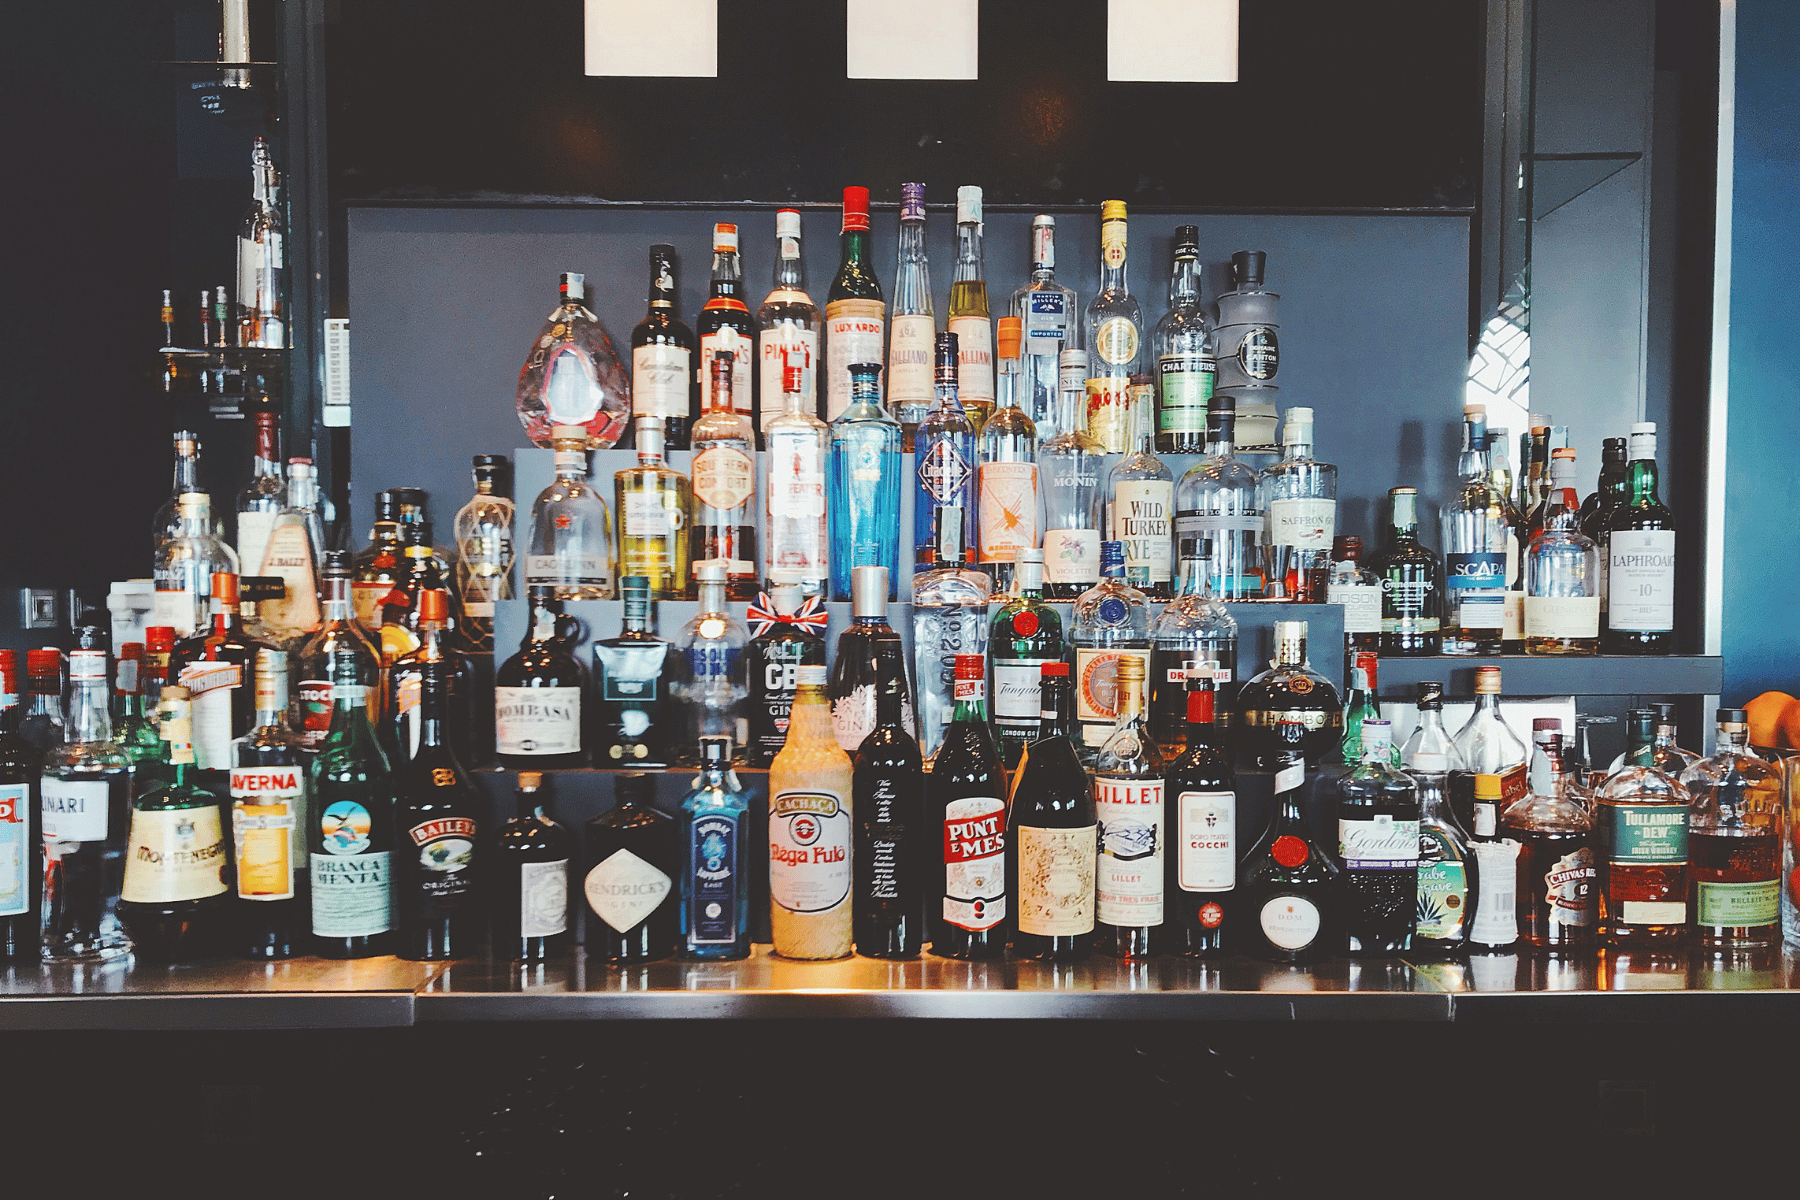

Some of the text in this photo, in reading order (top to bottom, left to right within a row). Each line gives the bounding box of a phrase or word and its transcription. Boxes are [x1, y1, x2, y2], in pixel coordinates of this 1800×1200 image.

[834, 322, 880, 334] LUXARDO
[890, 349, 928, 367] GALLIANO
[1162, 362, 1217, 373] CHARTREUSE
[1054, 477, 1098, 488] MONIN
[1130, 500, 1163, 518] WILD
[1122, 517, 1169, 536] TURKEY
[1280, 516, 1324, 526] SAFFRON
[1123, 539, 1151, 561] RYE
[1055, 567, 1093, 576] VIOLETTE
[1455, 560, 1505, 577] SCAPA
[1639, 583, 1653, 597] 10
[1329, 593, 1379, 604] UDSON
[765, 663, 798, 690] GB
[1169, 671, 1230, 680] DRUIE
[838, 720, 863, 731] GIN
[1256, 711, 1341, 726] CHAMBORD
[1002, 729, 1026, 737] LONDON
[232, 773, 298, 791] AVERNA
[1095, 784, 1162, 805] LILLET
[776, 798, 836, 813] CACHAÇA
[1623, 810, 1686, 826] TULLAMORE
[415, 820, 476, 841] BAILEYS
[947, 816, 999, 842] PUNT
[1642, 826, 1671, 839] DEW
[951, 832, 1006, 859] E MES
[1190, 841, 1229, 849] COCCHI
[317, 859, 381, 873] BRANCA
[317, 871, 380, 885] MENTA
[1111, 873, 1142, 883] LILLET
[1550, 868, 1585, 884] CHIVAS
[589, 881, 666, 896] HENDRICK'S
[1579, 884, 1589, 895] 12
